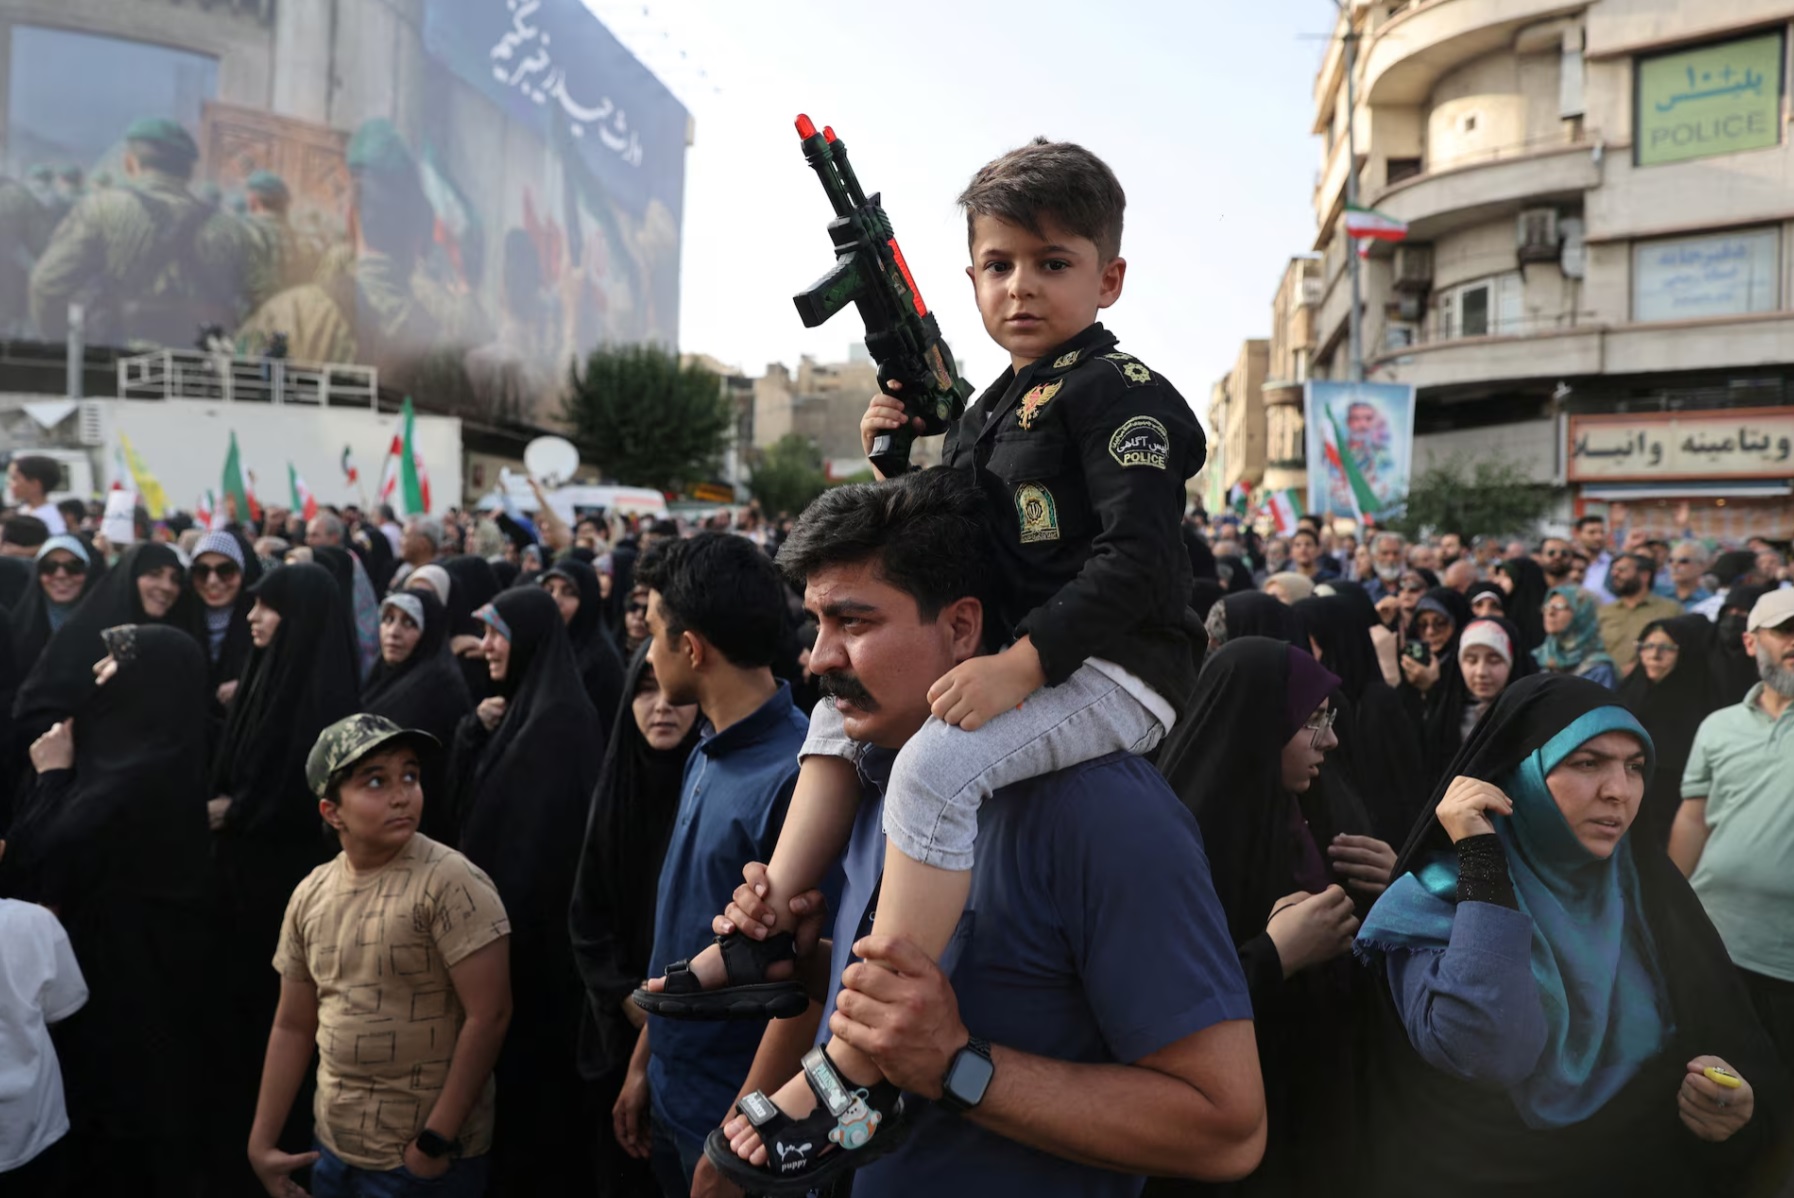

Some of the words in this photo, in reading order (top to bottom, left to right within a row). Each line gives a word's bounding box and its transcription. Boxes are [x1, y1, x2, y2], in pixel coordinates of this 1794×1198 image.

[1655, 66, 1763, 112] پلیس
[1652, 110, 1768, 148] POLICE
[1116, 435, 1149, 453] آگاهی
[1681, 426, 1792, 462] ویتامینه
[1124, 452, 1165, 466] POLICE
[781, 1159, 807, 1173] puppy
